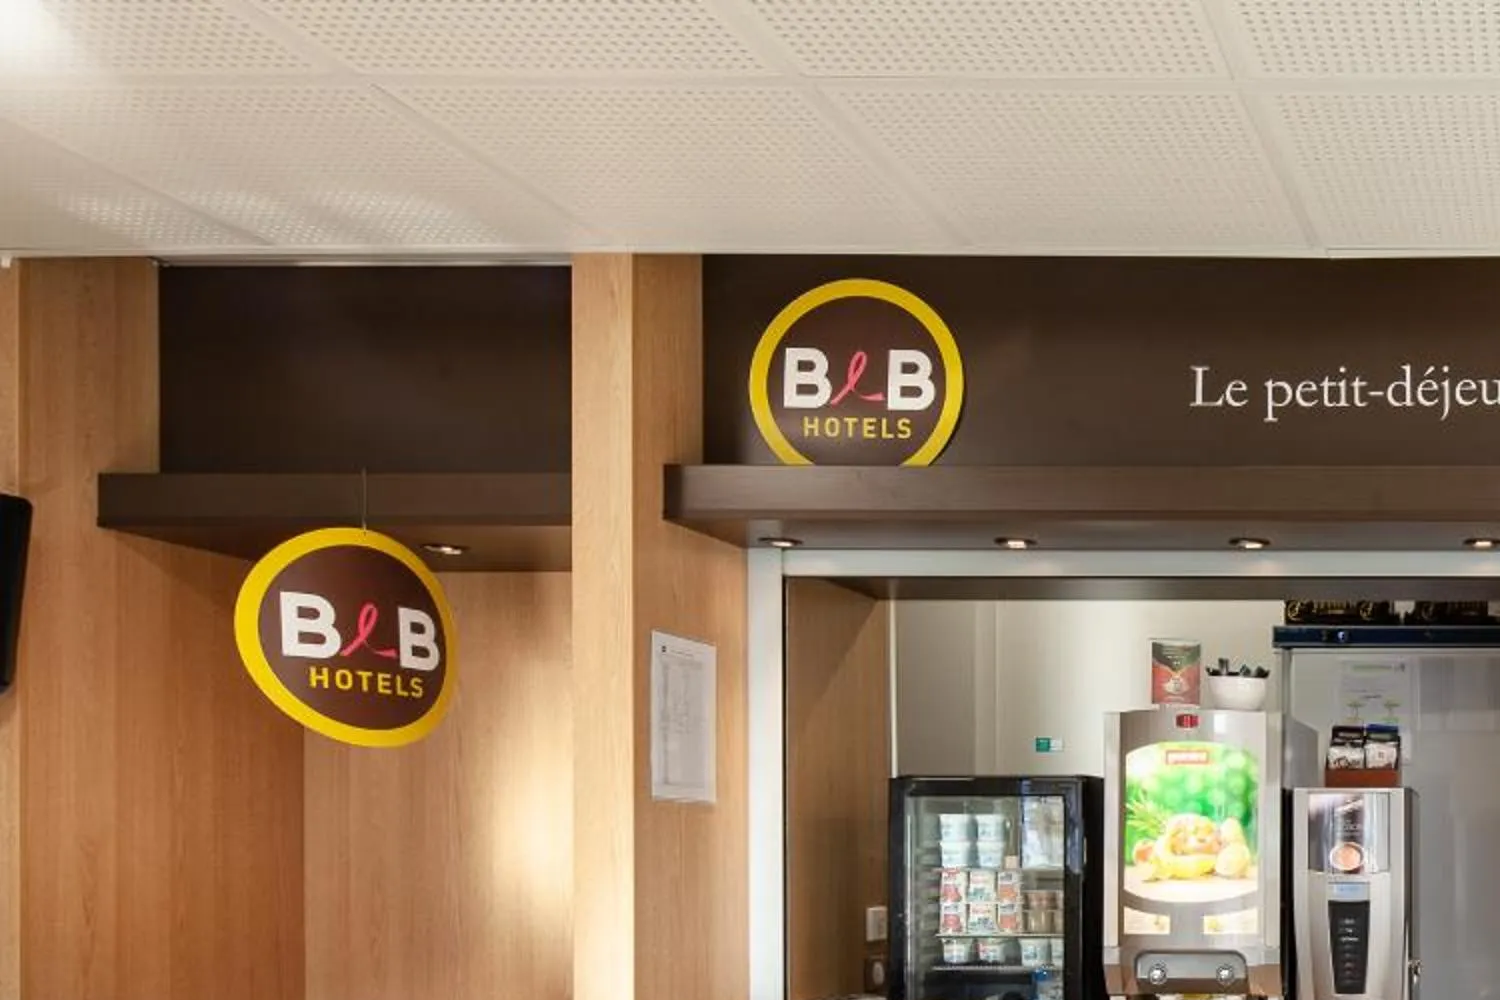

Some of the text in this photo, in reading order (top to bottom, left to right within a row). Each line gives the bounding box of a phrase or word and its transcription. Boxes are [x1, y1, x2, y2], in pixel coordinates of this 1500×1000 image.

[1189, 365, 1248, 407] Le
[803, 416, 912, 439] HOTELS
[308, 666, 424, 699] HOTELS
